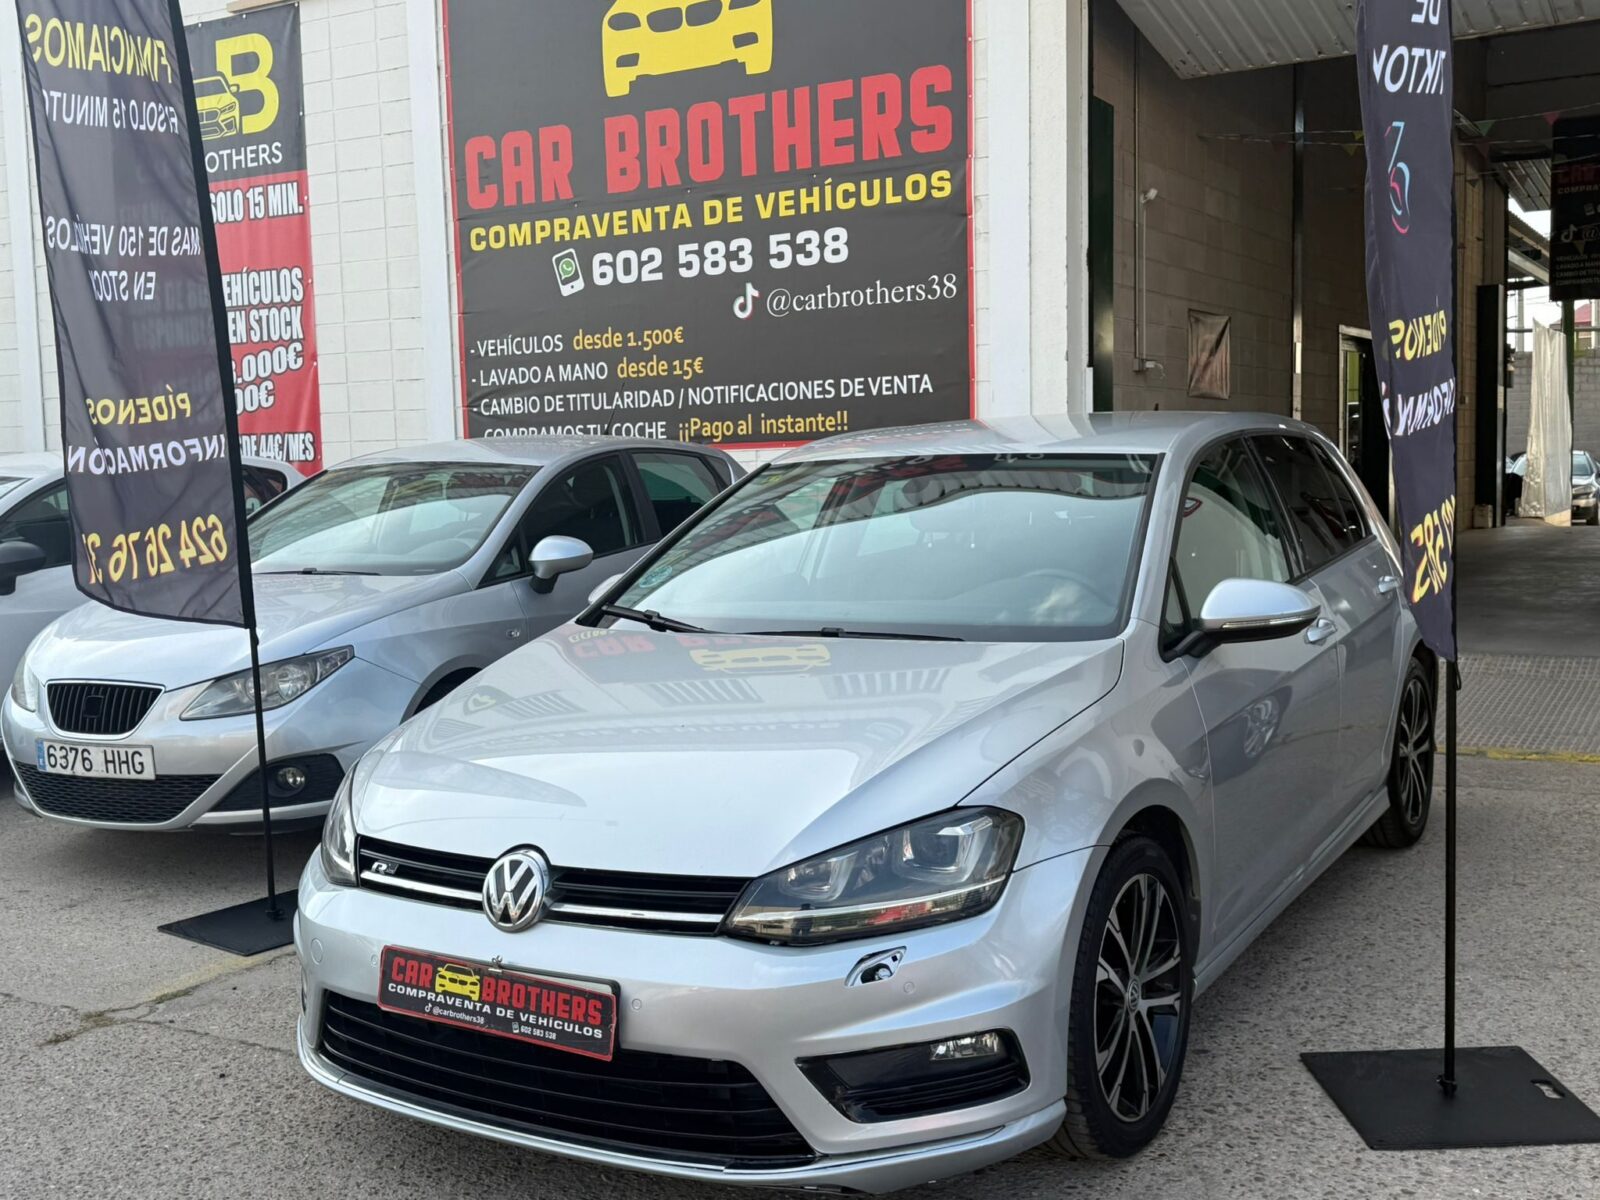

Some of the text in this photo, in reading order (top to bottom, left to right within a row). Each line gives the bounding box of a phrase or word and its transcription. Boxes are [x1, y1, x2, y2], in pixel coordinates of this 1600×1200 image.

[464, 64, 952, 209] CAR BROTHERS
[246, 186, 265, 219] 15
[267, 181, 304, 217] MIN.
[470, 169, 952, 252] COMPRAVENTA DE VEHÍCULOS
[592, 226, 849, 286] 602 583 538
[766, 273, 958, 318] @carbrothers38
[227, 305, 304, 344] EN STOCK
[573, 326, 623, 351] desde
[627, 326, 684, 351] 1.500€
[544, 364, 556, 383] A
[559, 361, 609, 382] MANO
[617, 354, 668, 379] desde
[672, 357, 704, 380] 15€
[544, 393, 565, 413] DE
[567, 388, 675, 412] TITULARIDAD
[688, 378, 835, 405] NOTIFICACIONES
[840, 377, 865, 398] DE
[868, 373, 933, 397] VENTA
[612, 421, 667, 440] COCHE
[737, 413, 752, 435] al
[760, 410, 848, 434] instante!!
[46, 744, 145, 775] 6376 HHG
[387, 982, 603, 1039] COMPRAVENTA DE VEHÍCULOS
[391, 956, 603, 1026] CAR BROTHERS
[432, 1005, 485, 1025] @carbrothers38
[520, 1025, 532, 1035] 602
